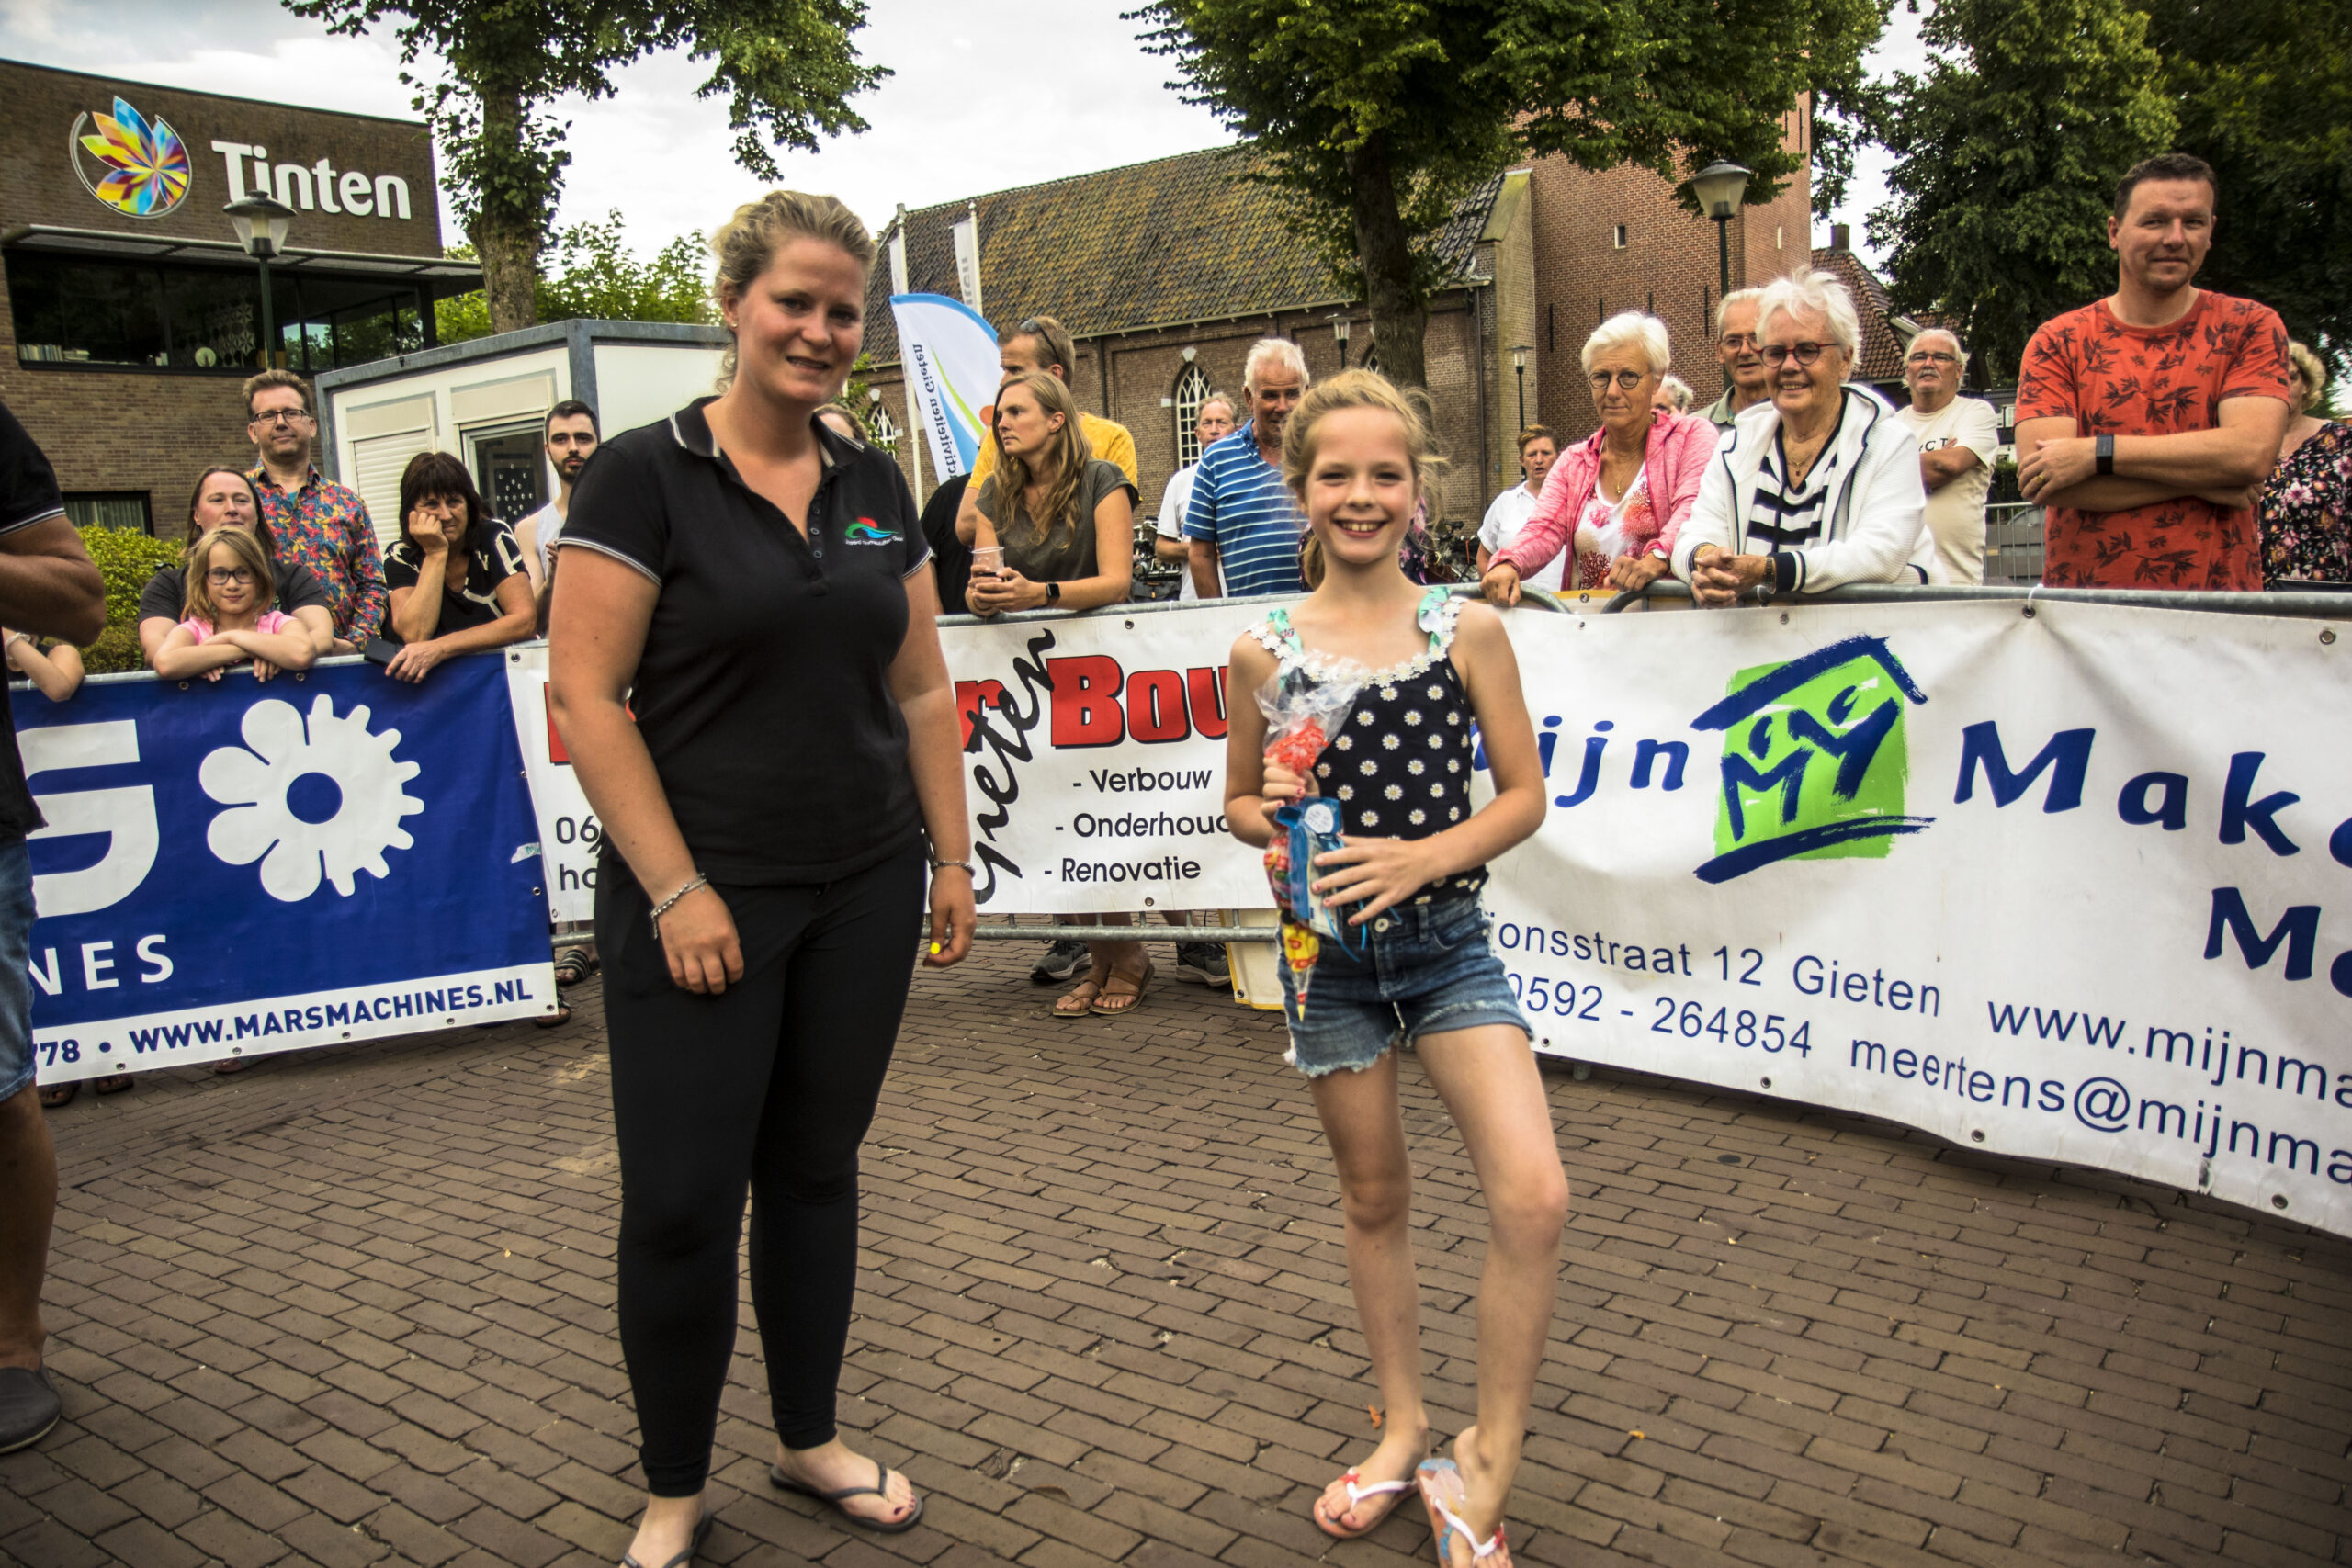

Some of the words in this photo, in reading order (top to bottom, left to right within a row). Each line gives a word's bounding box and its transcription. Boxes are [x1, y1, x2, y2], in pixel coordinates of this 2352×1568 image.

[210, 140, 412, 220] Tinten
[1918, 437, 1948, 452] CT
[1089, 767, 1213, 793] Verbouw
[1470, 716, 1690, 808] ijn
[1061, 856, 1201, 882] Renovatie
[34, 1039, 81, 1066] 78
[129, 978, 533, 1055] WWW.MARSMACHINES.NL
[1490, 911, 1692, 976] onsstraat
[1713, 945, 1763, 987] 12
[1792, 955, 1939, 1017] Gieten
[1987, 1000, 2352, 1109] www.mijnma
[1651, 996, 1812, 1059] 264854
[1850, 1037, 2352, 1185] meertens@mijnma
